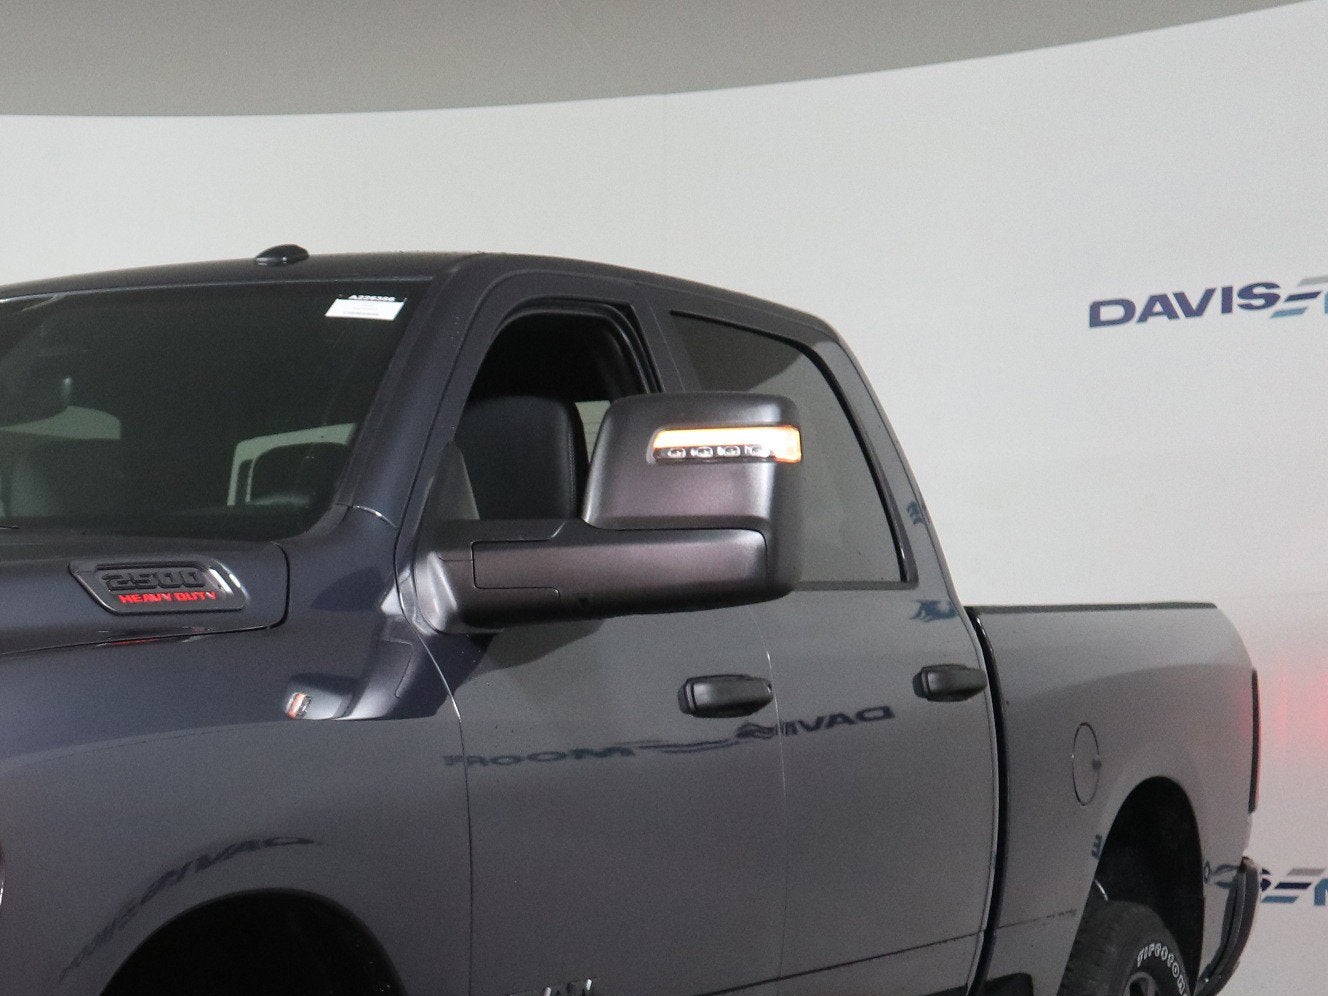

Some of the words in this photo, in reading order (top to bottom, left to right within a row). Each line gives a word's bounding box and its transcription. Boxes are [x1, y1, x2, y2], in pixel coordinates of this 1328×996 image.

[1088, 281, 1282, 329] DAVIS
[102, 566, 207, 592] 2500
[117, 592, 173, 604] HEAVY
[173, 591, 217, 602] DUTY
